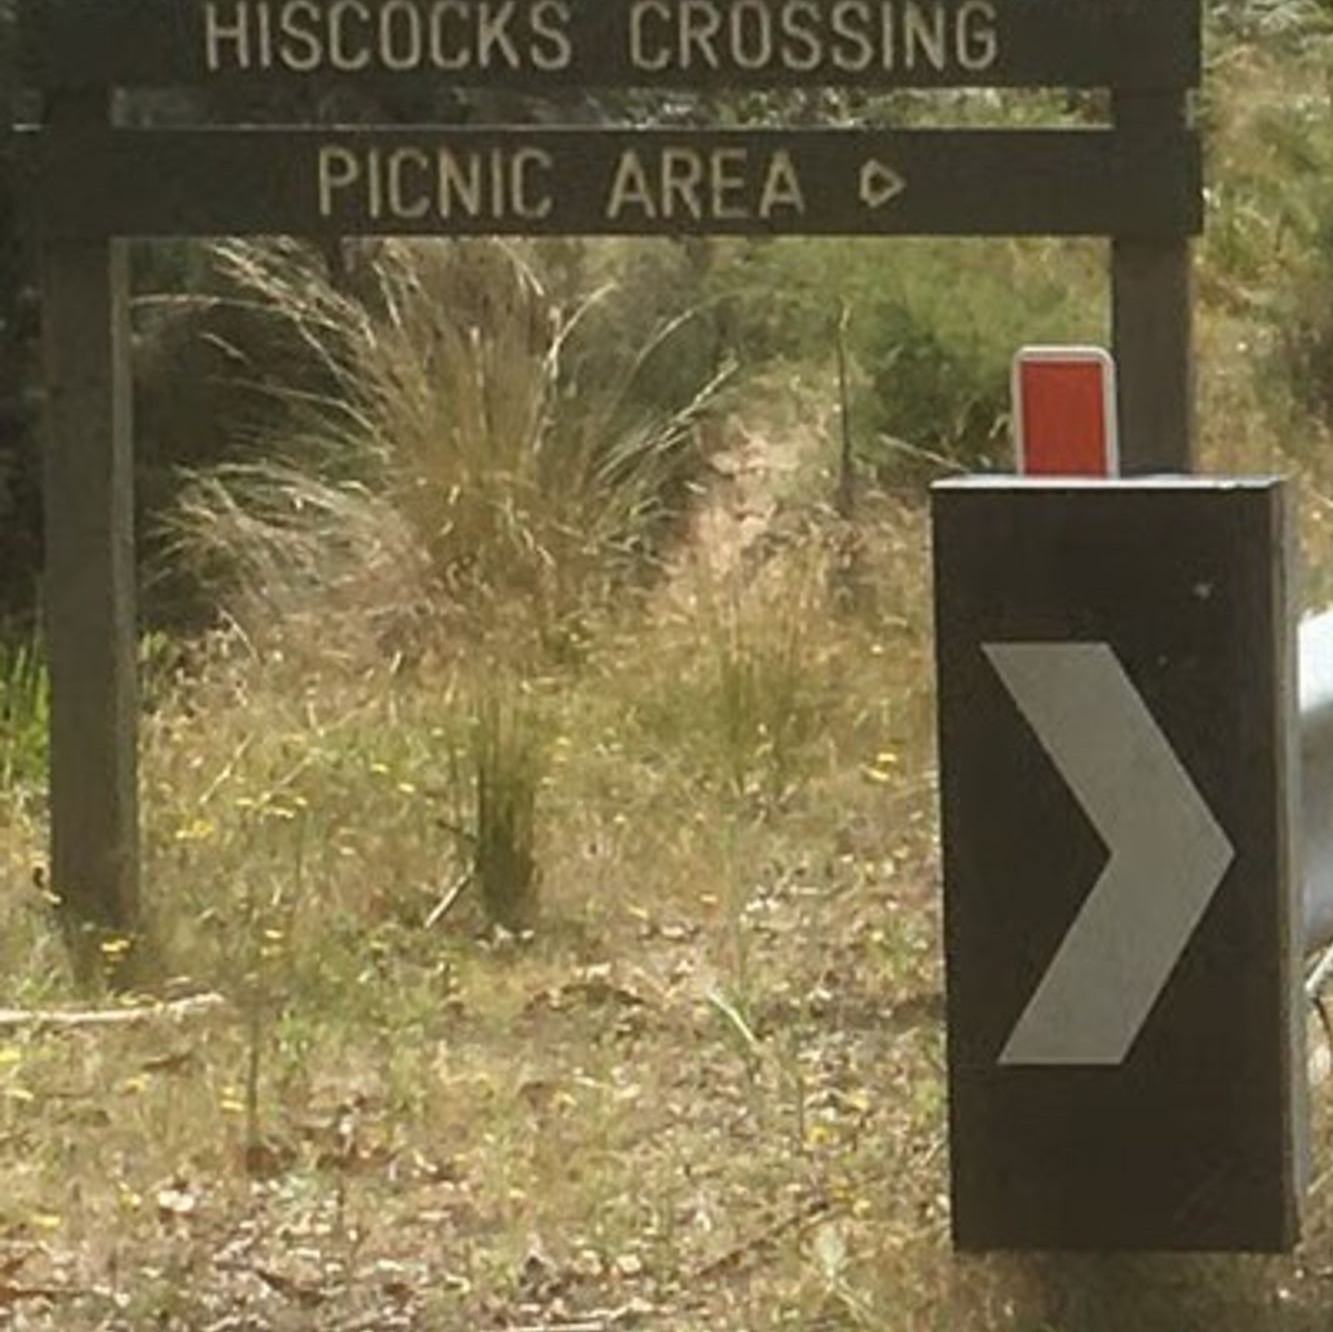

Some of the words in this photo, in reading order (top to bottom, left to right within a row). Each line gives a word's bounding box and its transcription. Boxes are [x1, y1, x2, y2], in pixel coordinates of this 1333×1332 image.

[202, 0, 573, 71] HISCOCKS
[629, 0, 999, 71] CROSSING
[317, 147, 554, 219] PICNIC
[606, 147, 805, 219] AREA
